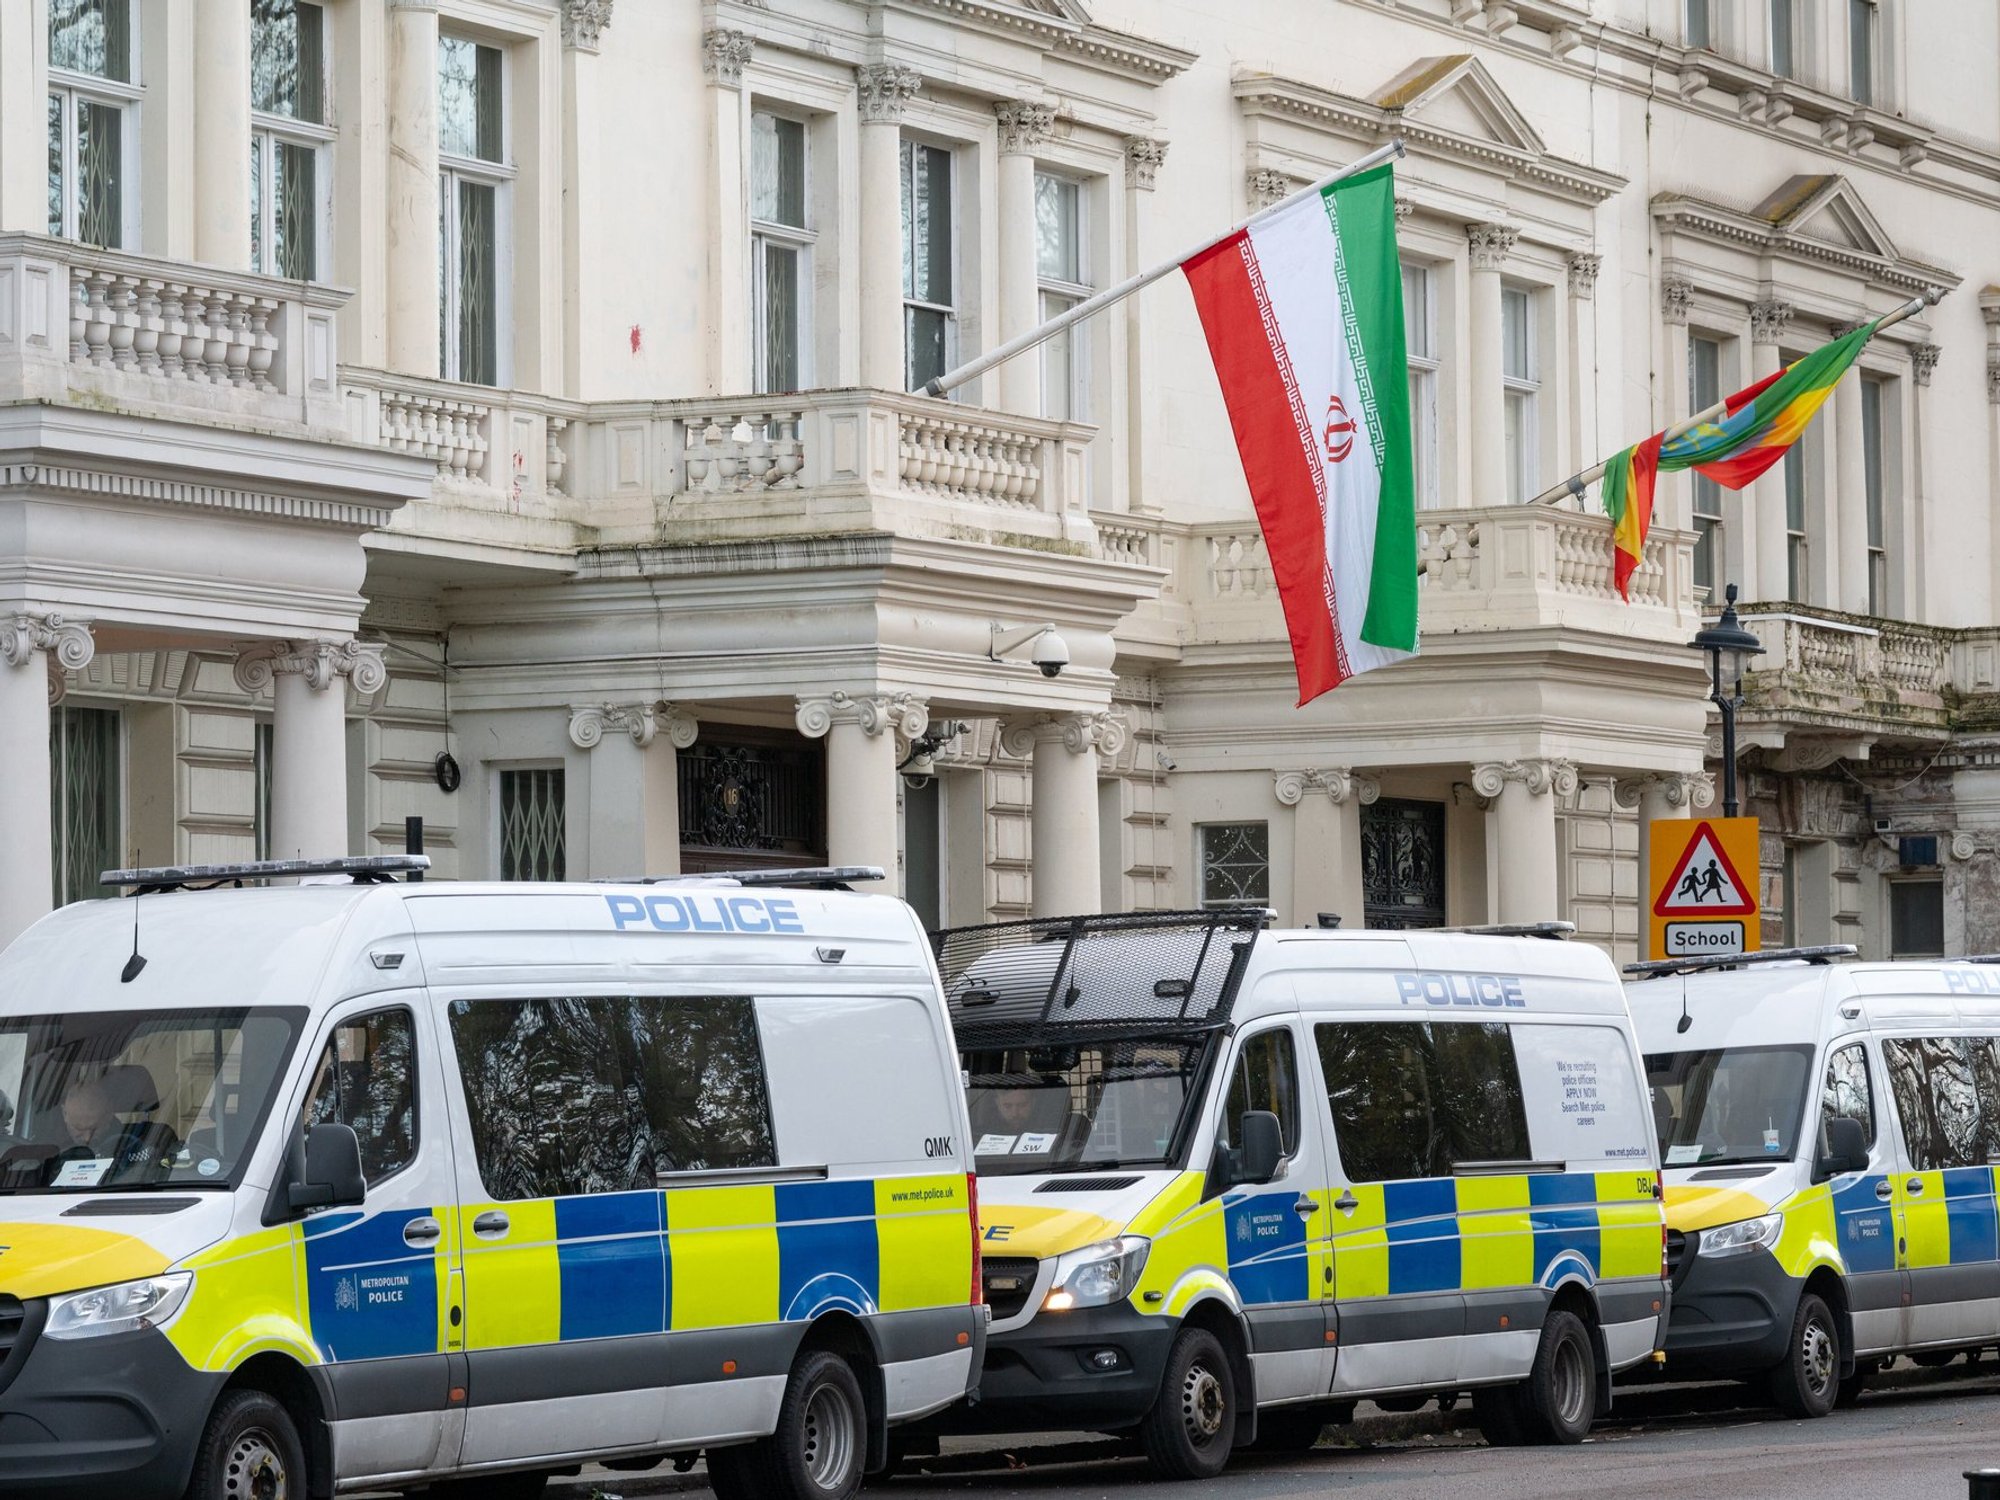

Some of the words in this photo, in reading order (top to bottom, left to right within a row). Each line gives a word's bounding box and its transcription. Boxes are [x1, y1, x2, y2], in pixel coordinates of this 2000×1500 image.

[604, 895, 805, 934] POLICE
[1674, 930, 1737, 946] School
[1393, 973, 1526, 1008] POLICE
[1562, 1075, 1577, 1087] police
[1566, 1088, 1582, 1099] APPLY
[1583, 1088, 1597, 1098] NOW
[1561, 1101, 1579, 1113] Search
[1579, 1101, 1590, 1112] Met
[1590, 1101, 1606, 1113] police
[1577, 1117, 1596, 1126] careers
[924, 1136, 953, 1158] QMK
[1637, 1177, 1652, 1194] DBJ
[891, 1187, 954, 1202] www.met.police.uk
[1252, 1214, 1283, 1224] METROPOLITAN
[1257, 1225, 1279, 1236] POLICE
[360, 1276, 409, 1289] METROPOLITAN
[368, 1290, 403, 1304] POLICE
